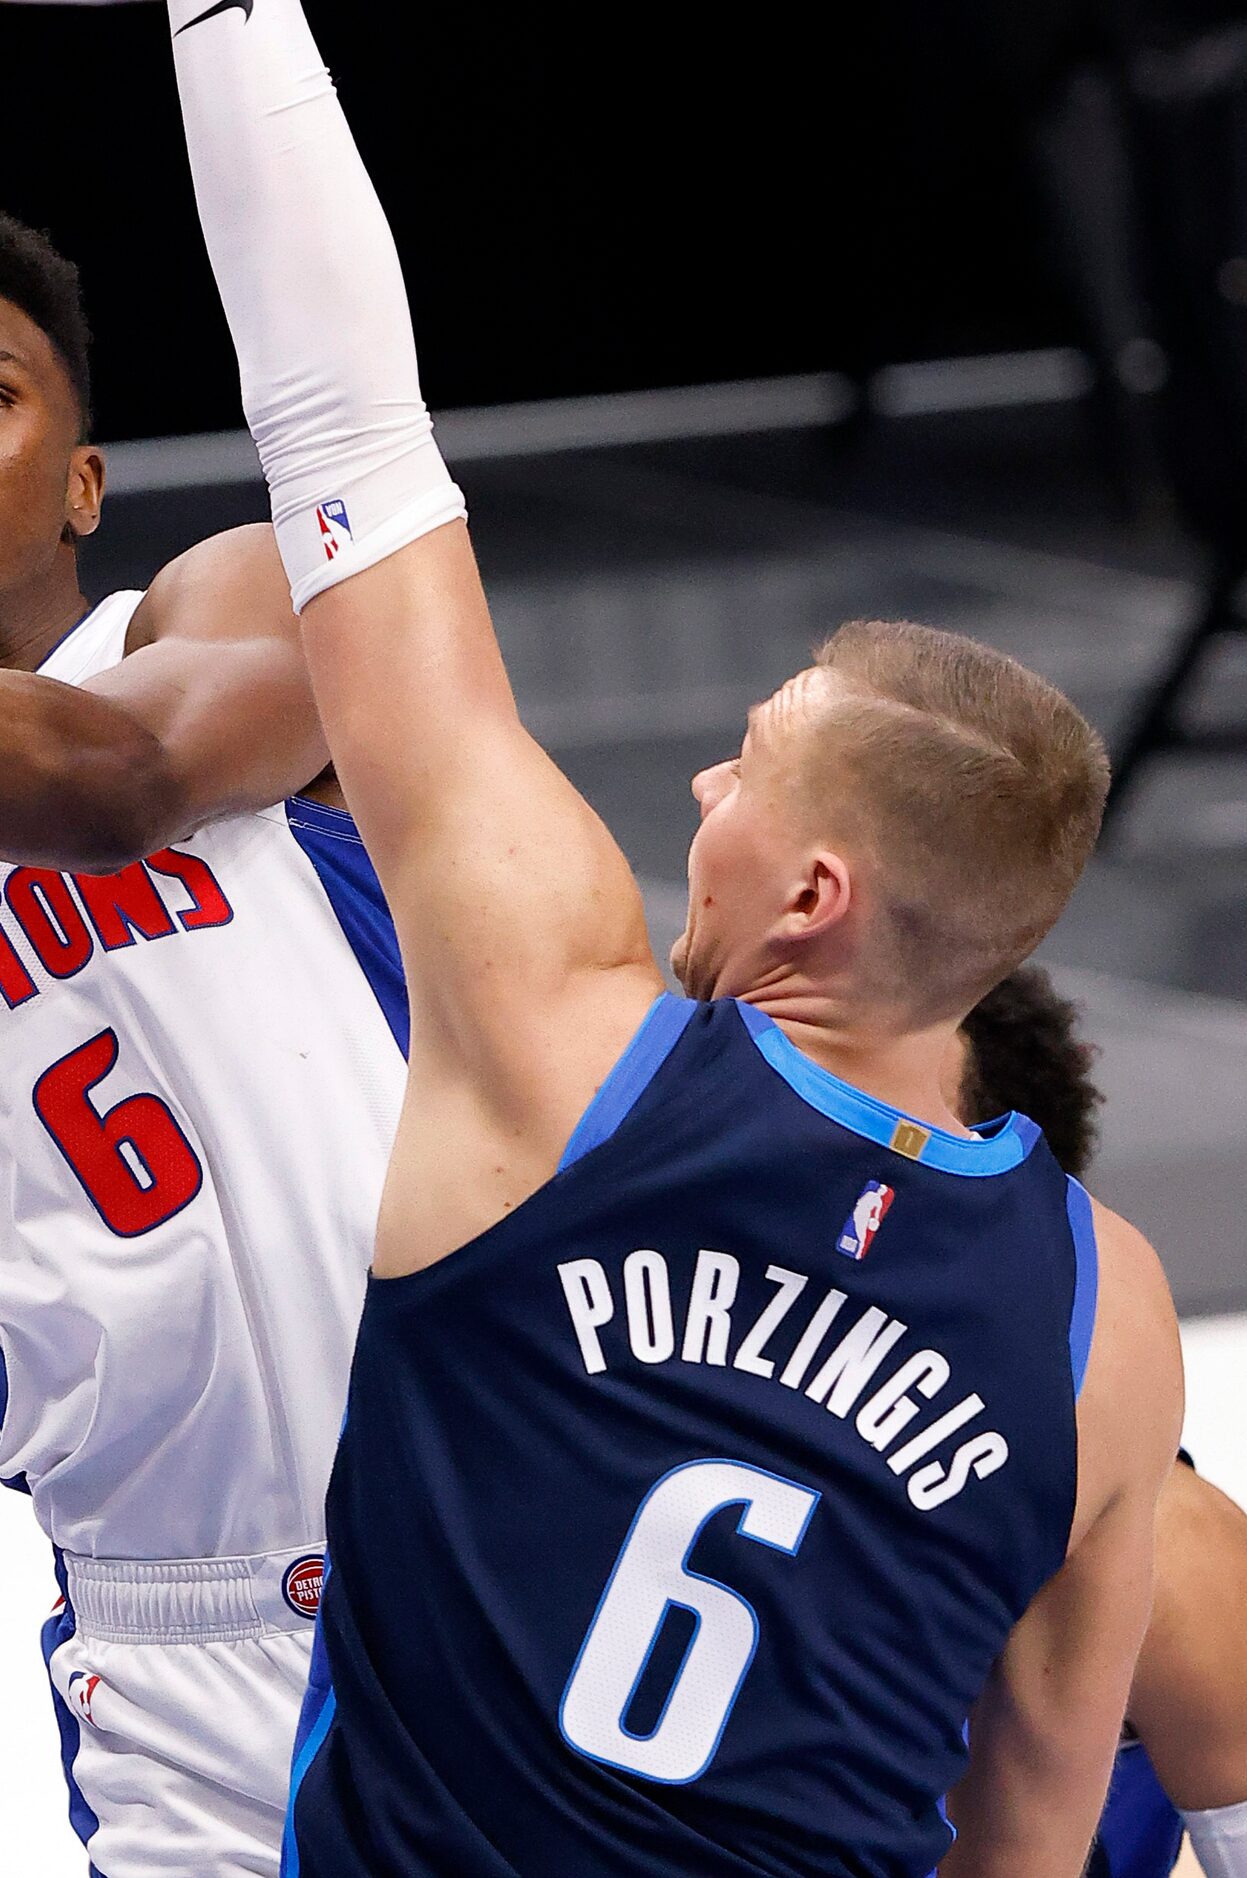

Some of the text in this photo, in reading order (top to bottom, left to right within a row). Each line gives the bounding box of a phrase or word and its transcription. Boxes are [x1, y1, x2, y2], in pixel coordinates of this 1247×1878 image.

[32, 1026, 203, 1239] 6
[556, 1249, 1009, 1511] PORZINGIS
[558, 1457, 822, 1785] 6
